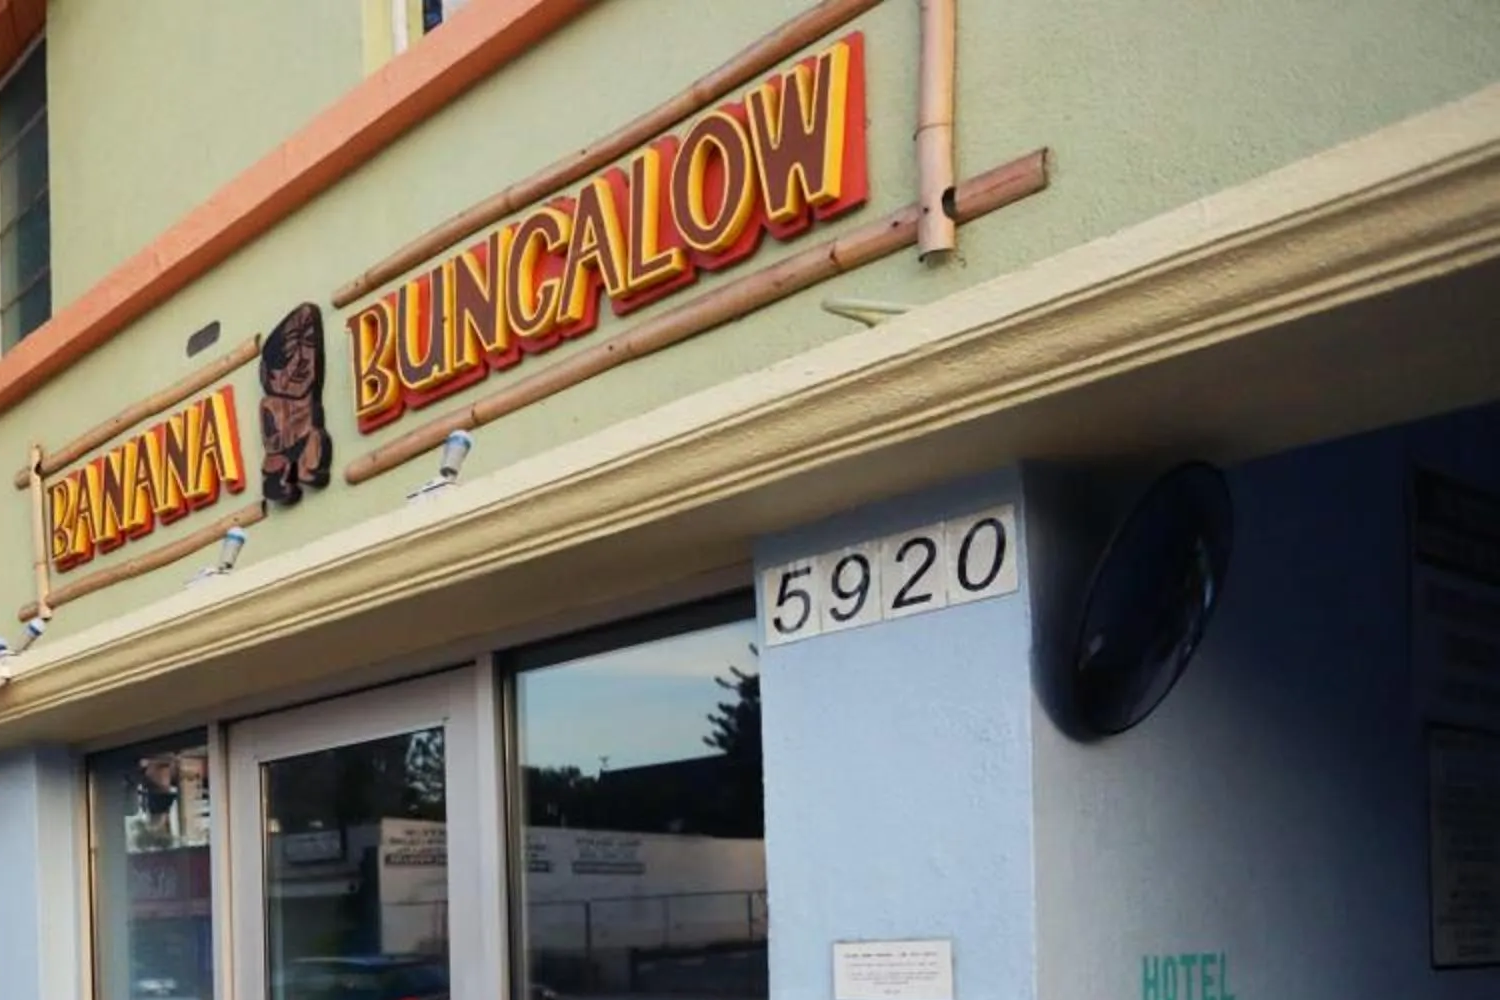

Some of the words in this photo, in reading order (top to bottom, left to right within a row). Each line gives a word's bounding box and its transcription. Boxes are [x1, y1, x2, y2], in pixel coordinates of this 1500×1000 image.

[48, 387, 242, 567] BANANA
[346, 34, 862, 426] BUNGALOW
[772, 517, 1008, 634] 5920
